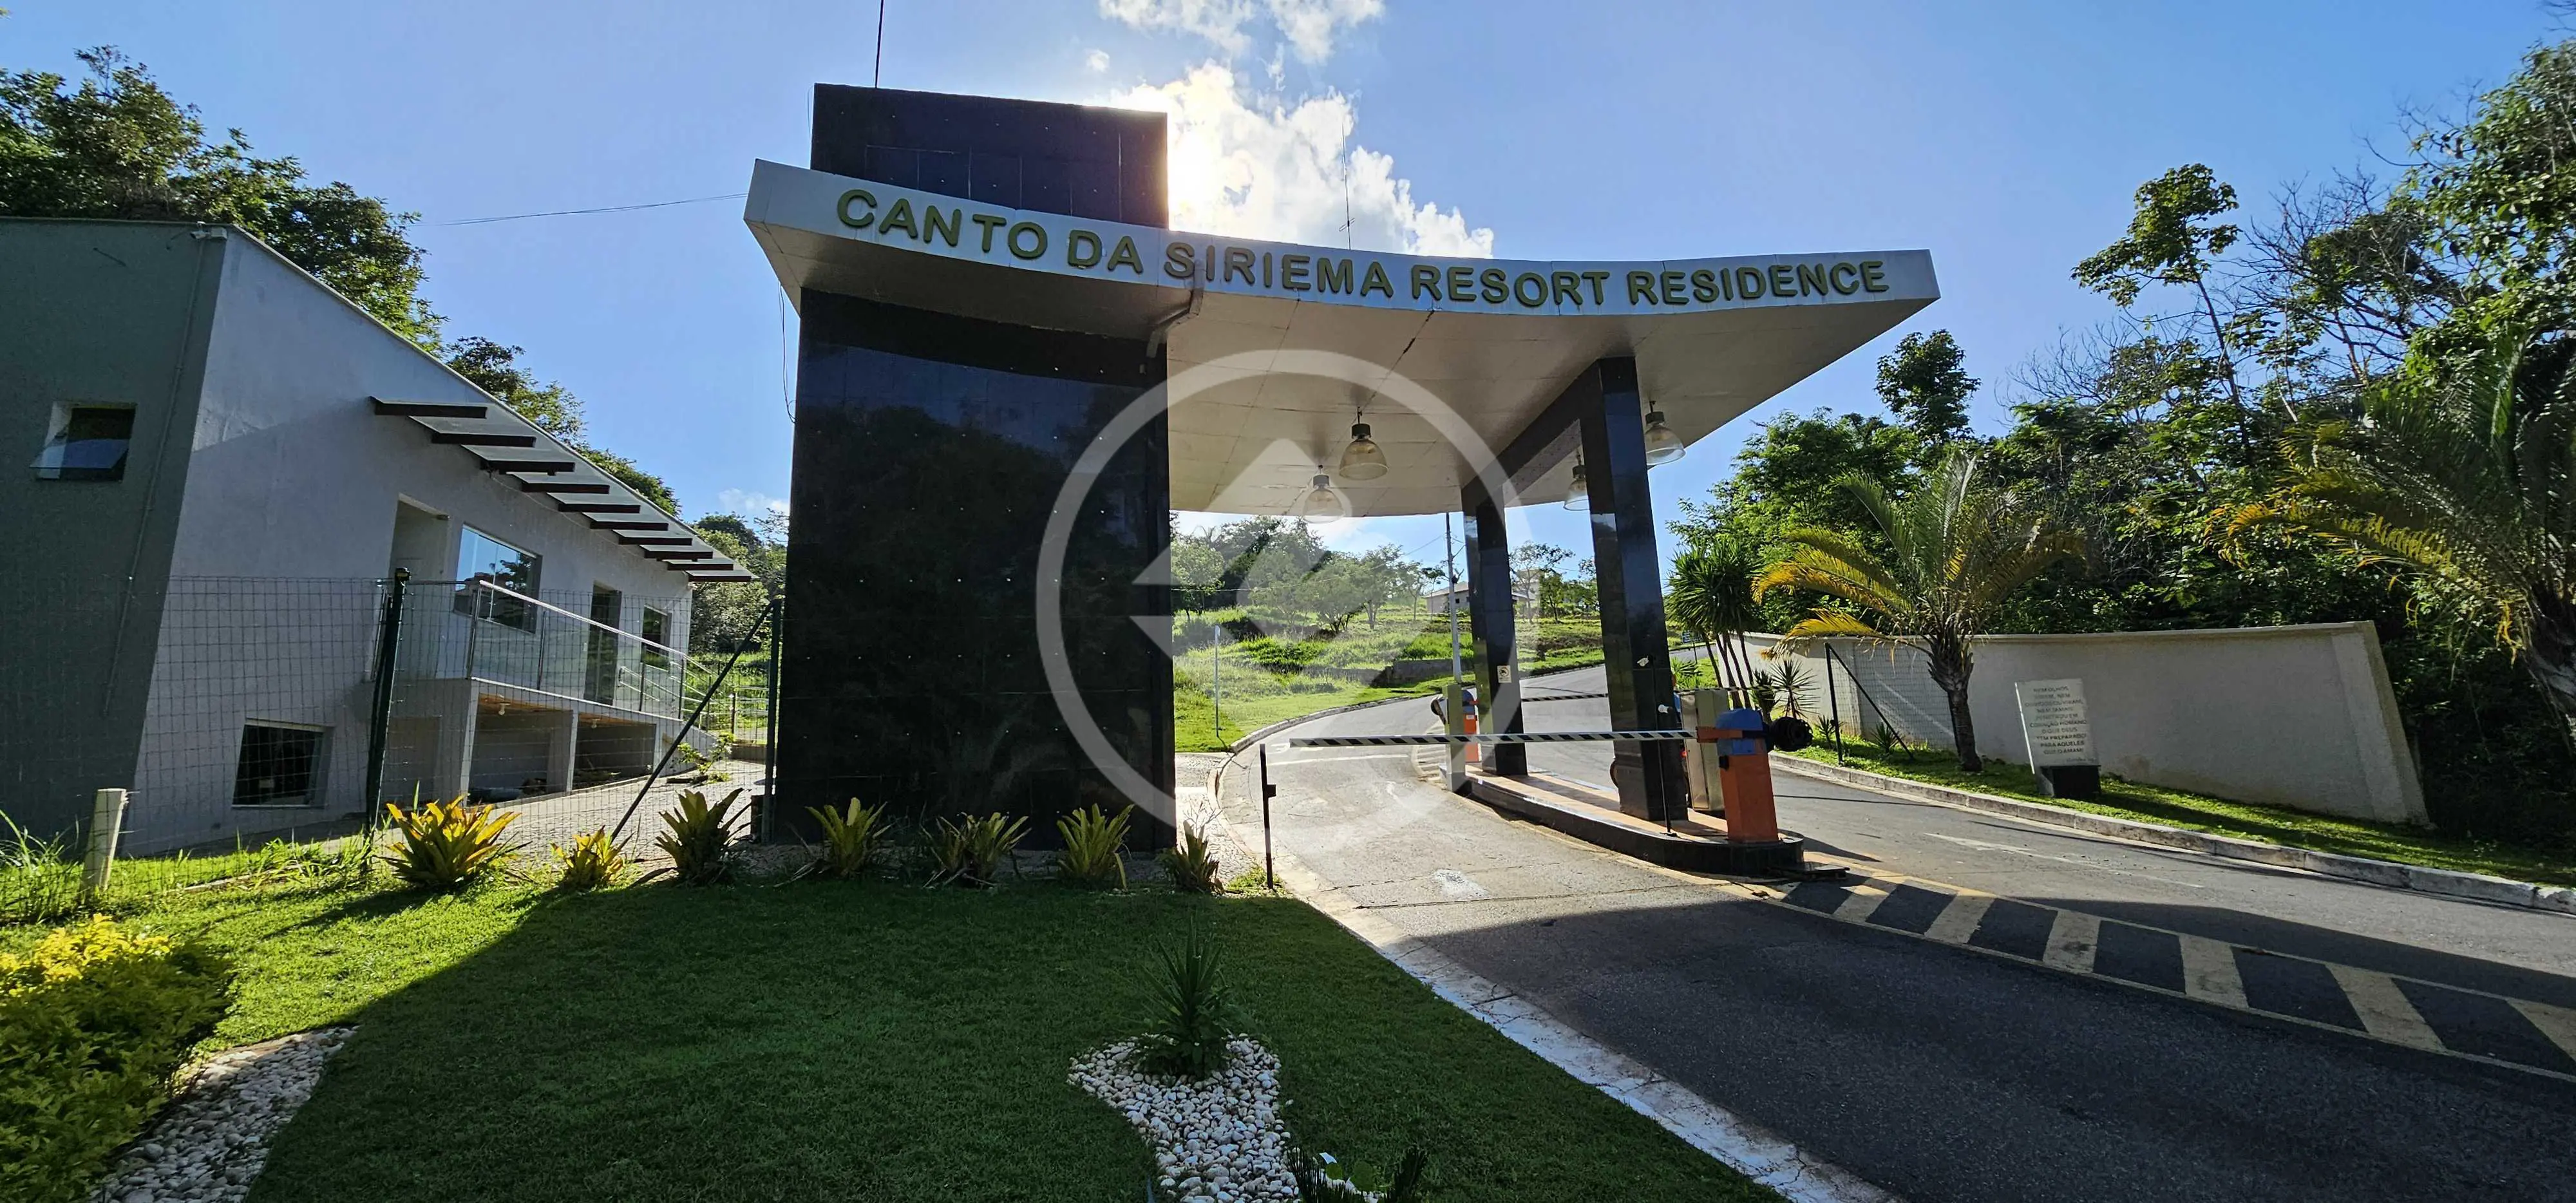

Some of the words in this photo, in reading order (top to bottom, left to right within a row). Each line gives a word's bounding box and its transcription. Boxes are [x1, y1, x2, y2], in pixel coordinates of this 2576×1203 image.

[837, 189, 1048, 259] CANTO
[1068, 229, 1144, 274] DA
[1164, 242, 1394, 298] SIRIEMA
[1412, 264, 1611, 307] RESORT
[1627, 261, 1889, 305] RESIDENCE
